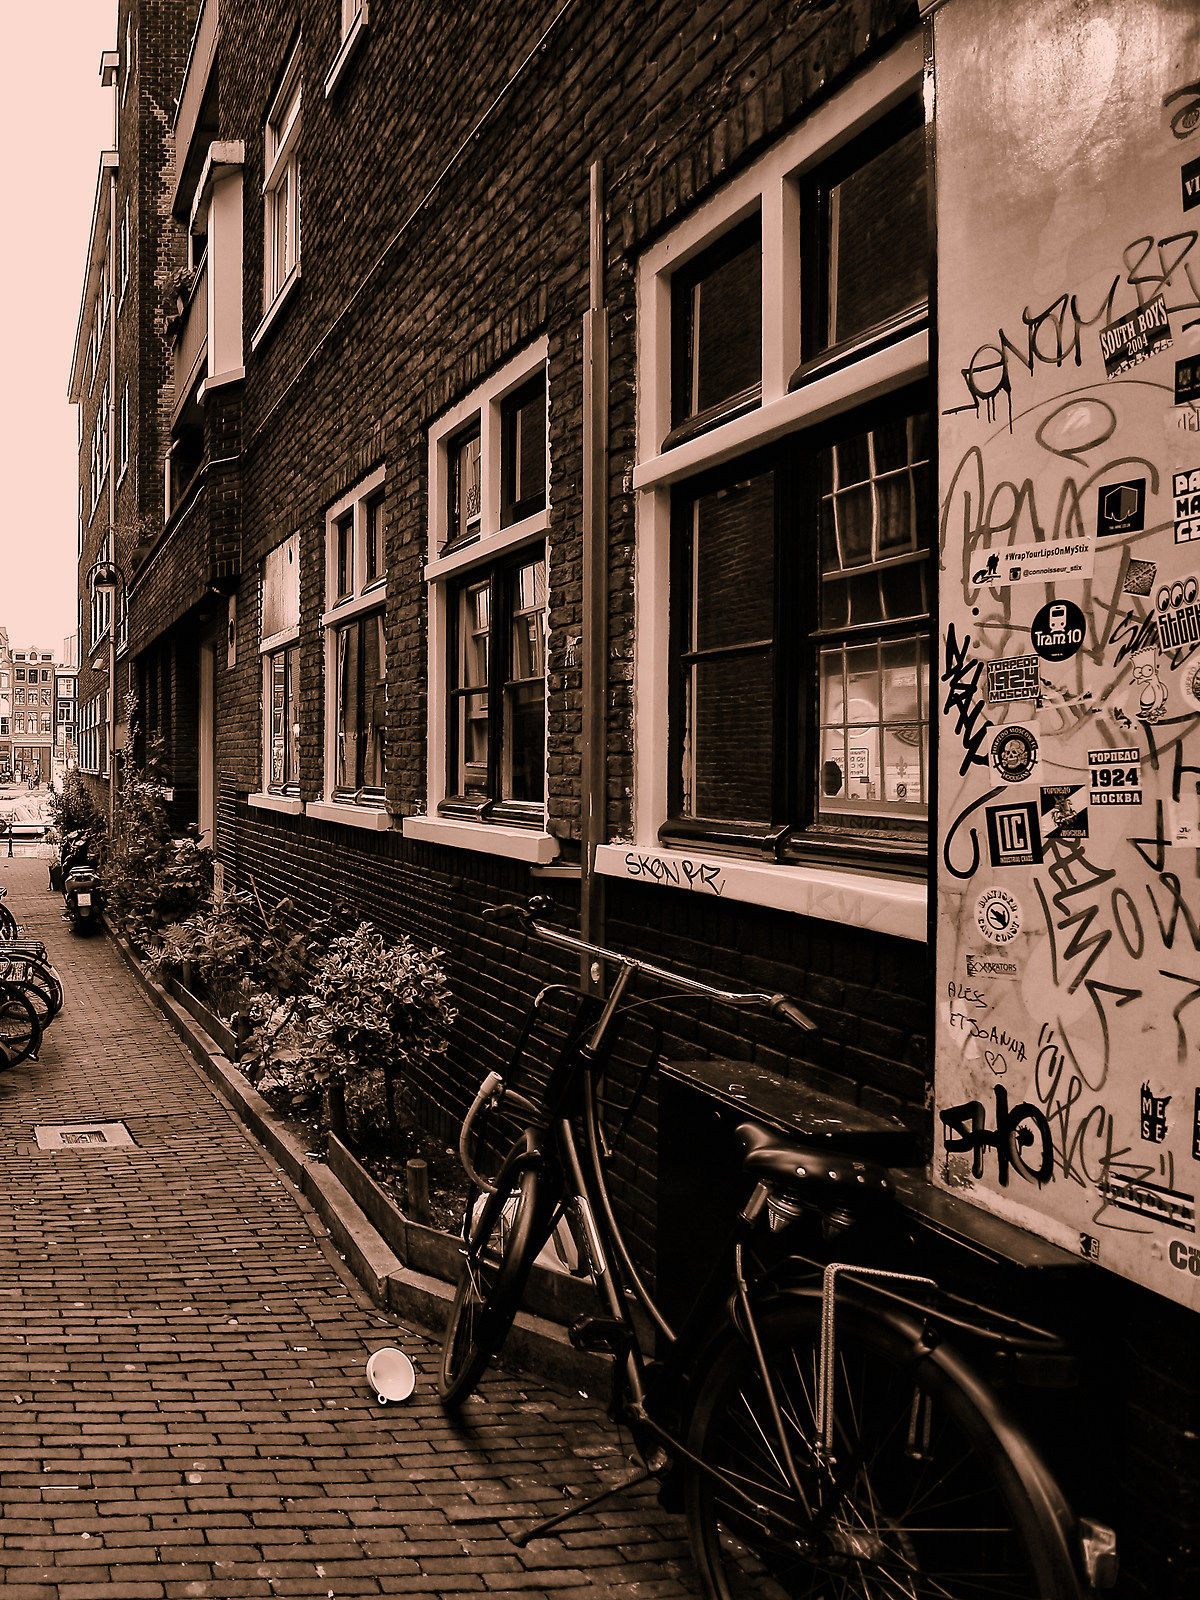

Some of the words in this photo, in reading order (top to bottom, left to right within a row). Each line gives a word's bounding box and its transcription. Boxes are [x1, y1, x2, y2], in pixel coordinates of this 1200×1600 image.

[1100, 321, 1136, 361] SOUTH
[1139, 297, 1168, 332] BOYS
[1126, 333, 1149, 357] 2004
[989, 656, 1039, 671] TORPEDO
[989, 667, 1039, 691] 1924
[990, 686, 1039, 701] MOSCOW
[1090, 751, 1139, 763] ТОРПЕДО
[1091, 768, 1139, 787] 1924
[1091, 793, 1140, 804] МОСКВА
